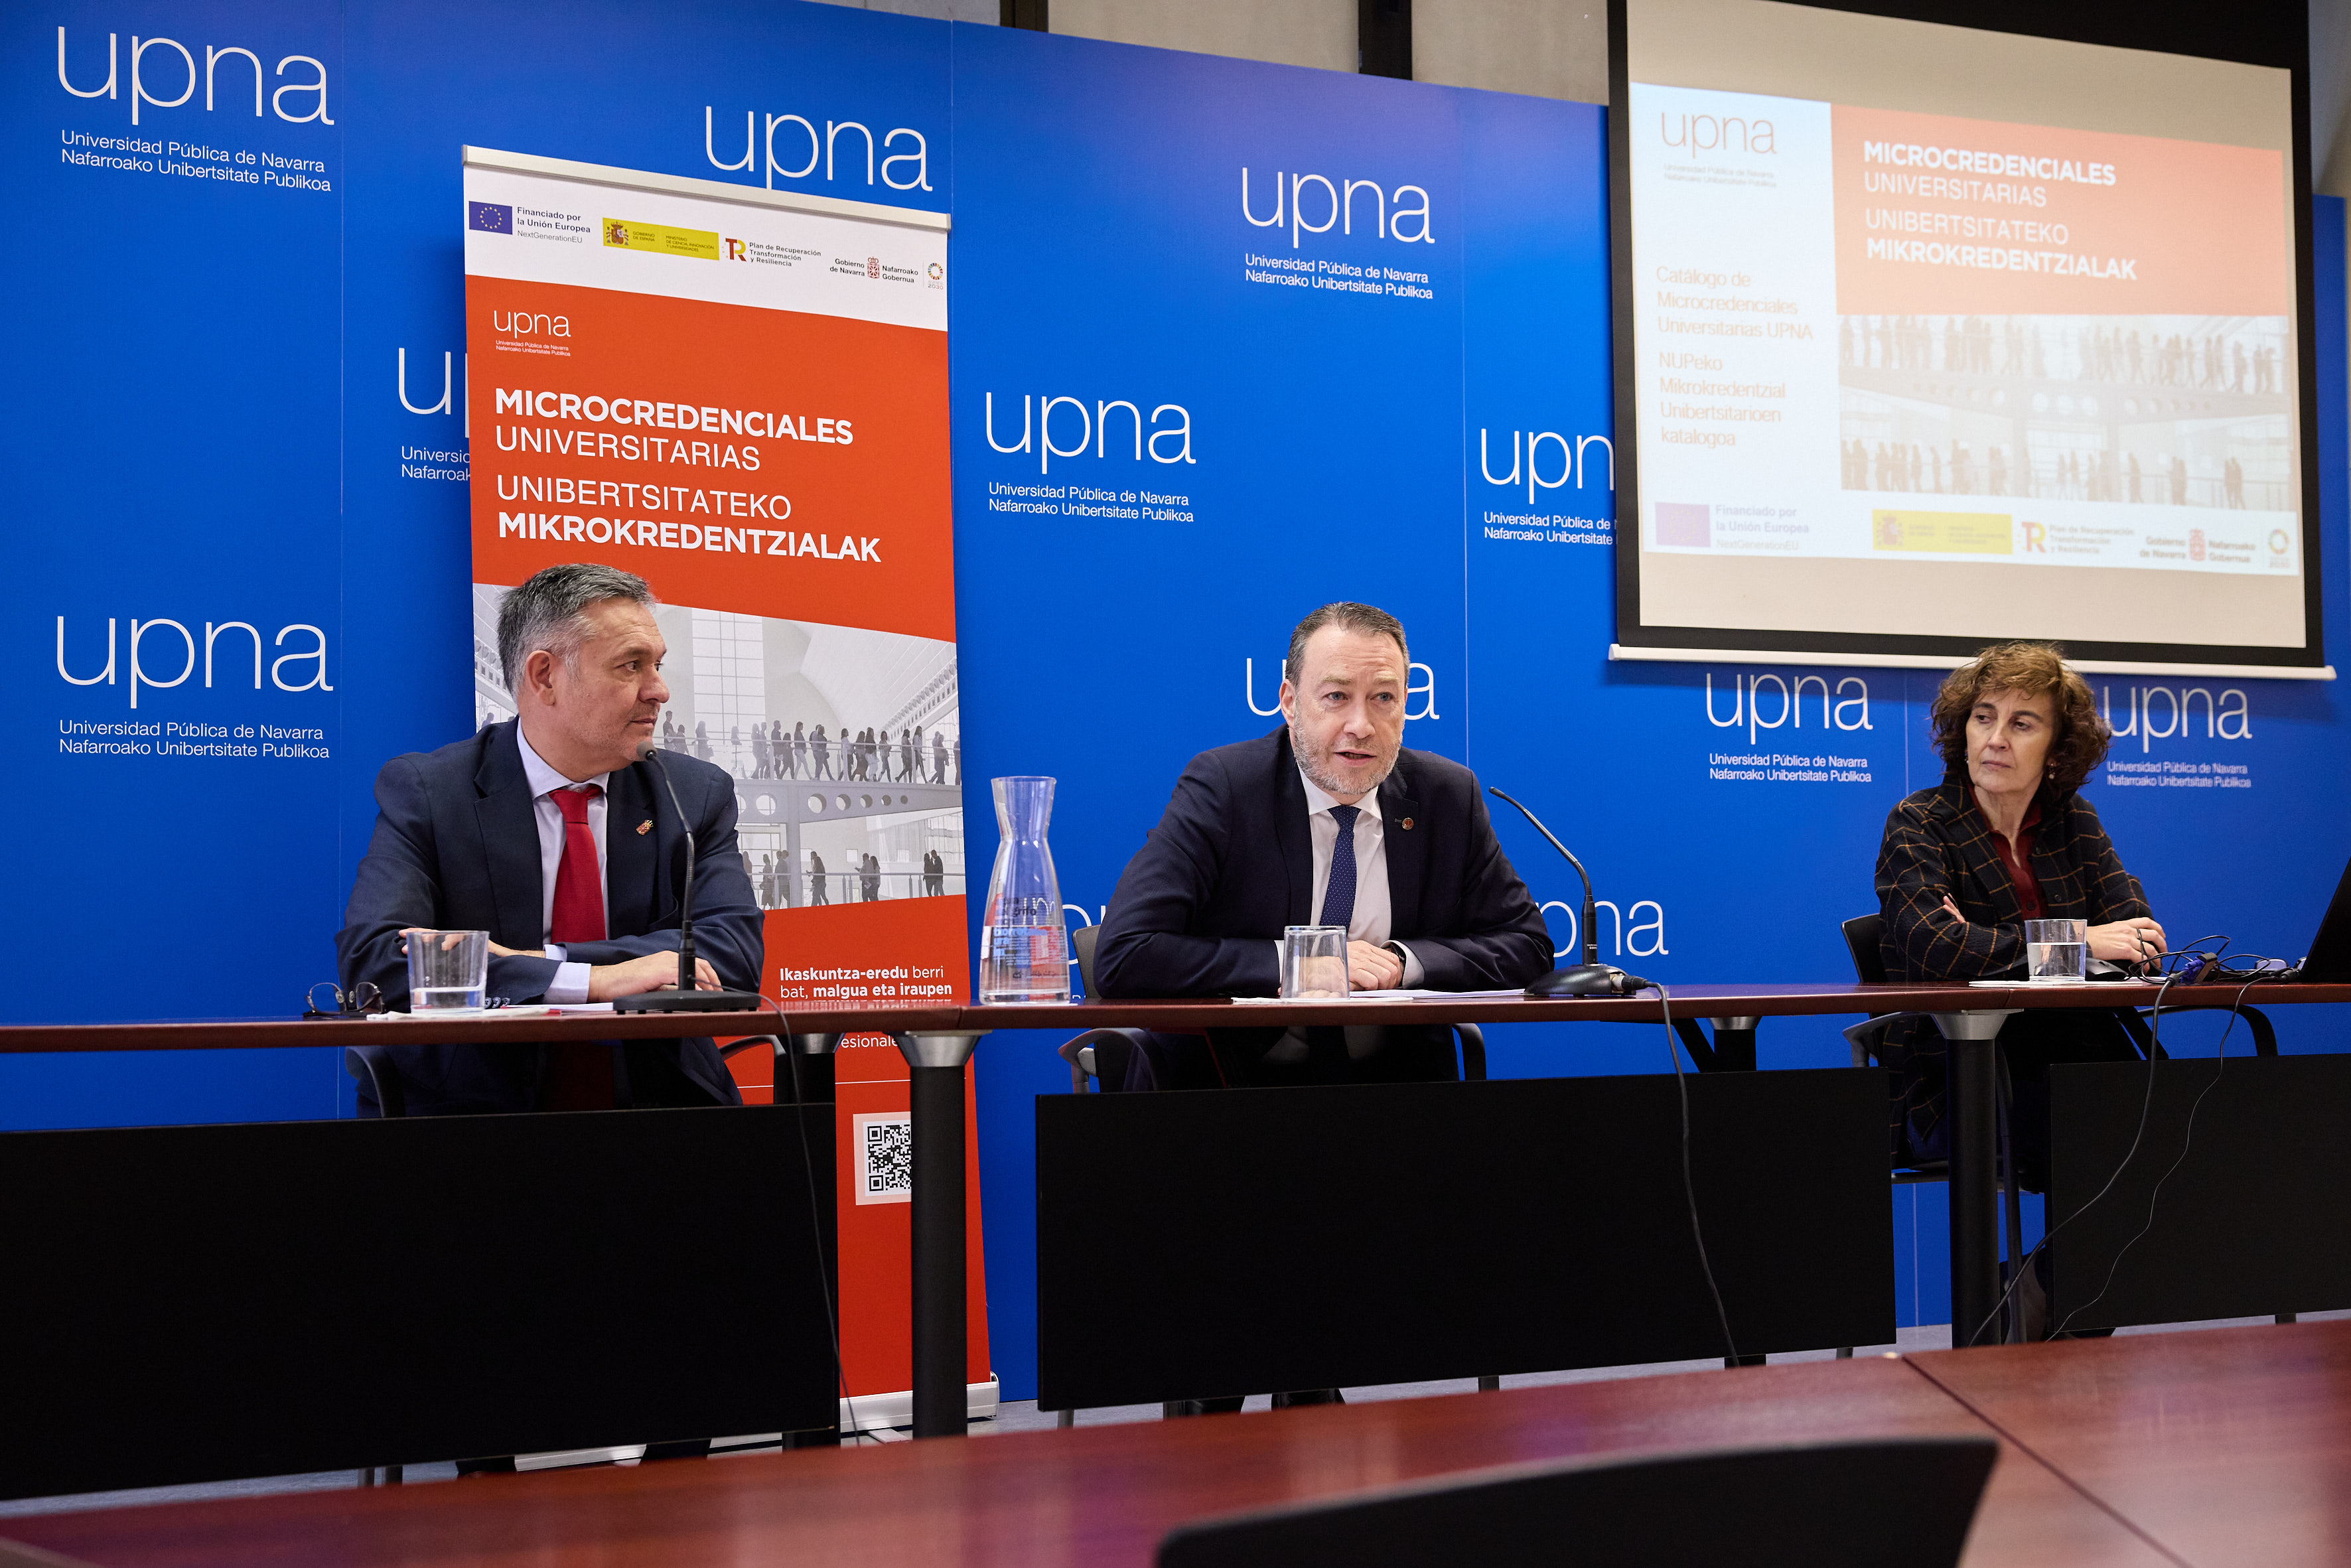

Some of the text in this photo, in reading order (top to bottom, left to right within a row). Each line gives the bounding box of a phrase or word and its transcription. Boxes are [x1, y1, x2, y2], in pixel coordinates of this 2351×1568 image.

[58, 27, 334, 125] upna
[1662, 112, 1777, 159] upna
[62, 129, 324, 173] Universidad Pública de Navarra
[706, 106, 933, 191] upna
[62, 149, 331, 191] Nafarroako Unibertsitate Publikoa
[1864, 141, 2116, 186] MICROCREDENCIALES
[1865, 171, 2046, 207] UNIVERSITARIAS
[518, 207, 564, 219] Financiado
[1242, 167, 1435, 248] upna
[518, 230, 583, 244] NextGenerationEU
[528, 218, 552, 228] Unión
[555, 223, 591, 233] Europea
[1866, 208, 2069, 245] UNIBERTSITATEKO
[749, 249, 802, 261] Transformación
[756, 257, 792, 266] Resiliencia
[776, 246, 821, 256] Recuperación
[835, 258, 865, 268] Gobierno
[1867, 238, 2137, 280] MIKROKREDENTZIALAK
[840, 268, 865, 277] Navarra
[883, 265, 918, 275] Nafarroako
[883, 274, 914, 283] Gobernua
[1246, 253, 1428, 283] Universidad Pública de Navarra
[1656, 265, 1751, 289] Catálogo de
[1246, 269, 1433, 299] Nafarroako Unibertsitate Publikoa
[1658, 291, 1798, 315] Microcredenciales
[494, 310, 571, 339] upna
[1658, 315, 1814, 340] Universitarias UPNA
[1659, 351, 1723, 371] NUPeko
[1660, 376, 1786, 398] Mikrokredentzial
[496, 388, 853, 445] MICROCREDENCIALES
[1661, 401, 1782, 422] Unibertsitarioen
[986, 392, 1196, 474] upna
[1662, 426, 1736, 449] katalogoa
[401, 446, 470, 463] Universi
[496, 425, 760, 471] UNIVERSITARIAS
[401, 464, 470, 481] Nafarroak
[1481, 429, 1614, 504] upn
[497, 474, 792, 520] UNIBERTSITATEKO
[989, 482, 1188, 506] Universidad Pública de Navarra
[989, 498, 1194, 522] Nafarroako Unibertsitate Publikoa
[1484, 511, 1610, 530] Universidad Pública de
[1716, 504, 1797, 518] Financiado por
[499, 512, 881, 562] MIKROKREDENTZIALAK
[1484, 526, 1544, 541] Nafarroako
[1547, 530, 1613, 545] Unibertsitate
[1764, 522, 1810, 535] Europea
[57, 616, 334, 709] upna
[1247, 658, 1439, 720] ua
[1706, 673, 1873, 745] upna
[2103, 686, 2253, 753] upna
[60, 719, 323, 740] Universidad Pública de Navarra
[60, 739, 330, 758] Nafarroako Unibertsitate Publikoa
[1709, 753, 1868, 768] Universidad Pública de Navarra
[1710, 768, 1871, 782] Nafarroako Unibertsitate Publikoa
[1535, 900, 1669, 958] pna
[780, 965, 944, 981] Ikaskuntza-eredu berri
[780, 983, 952, 999] bat, malgua eta iraupen
[841, 1035, 898, 1048] esionale
